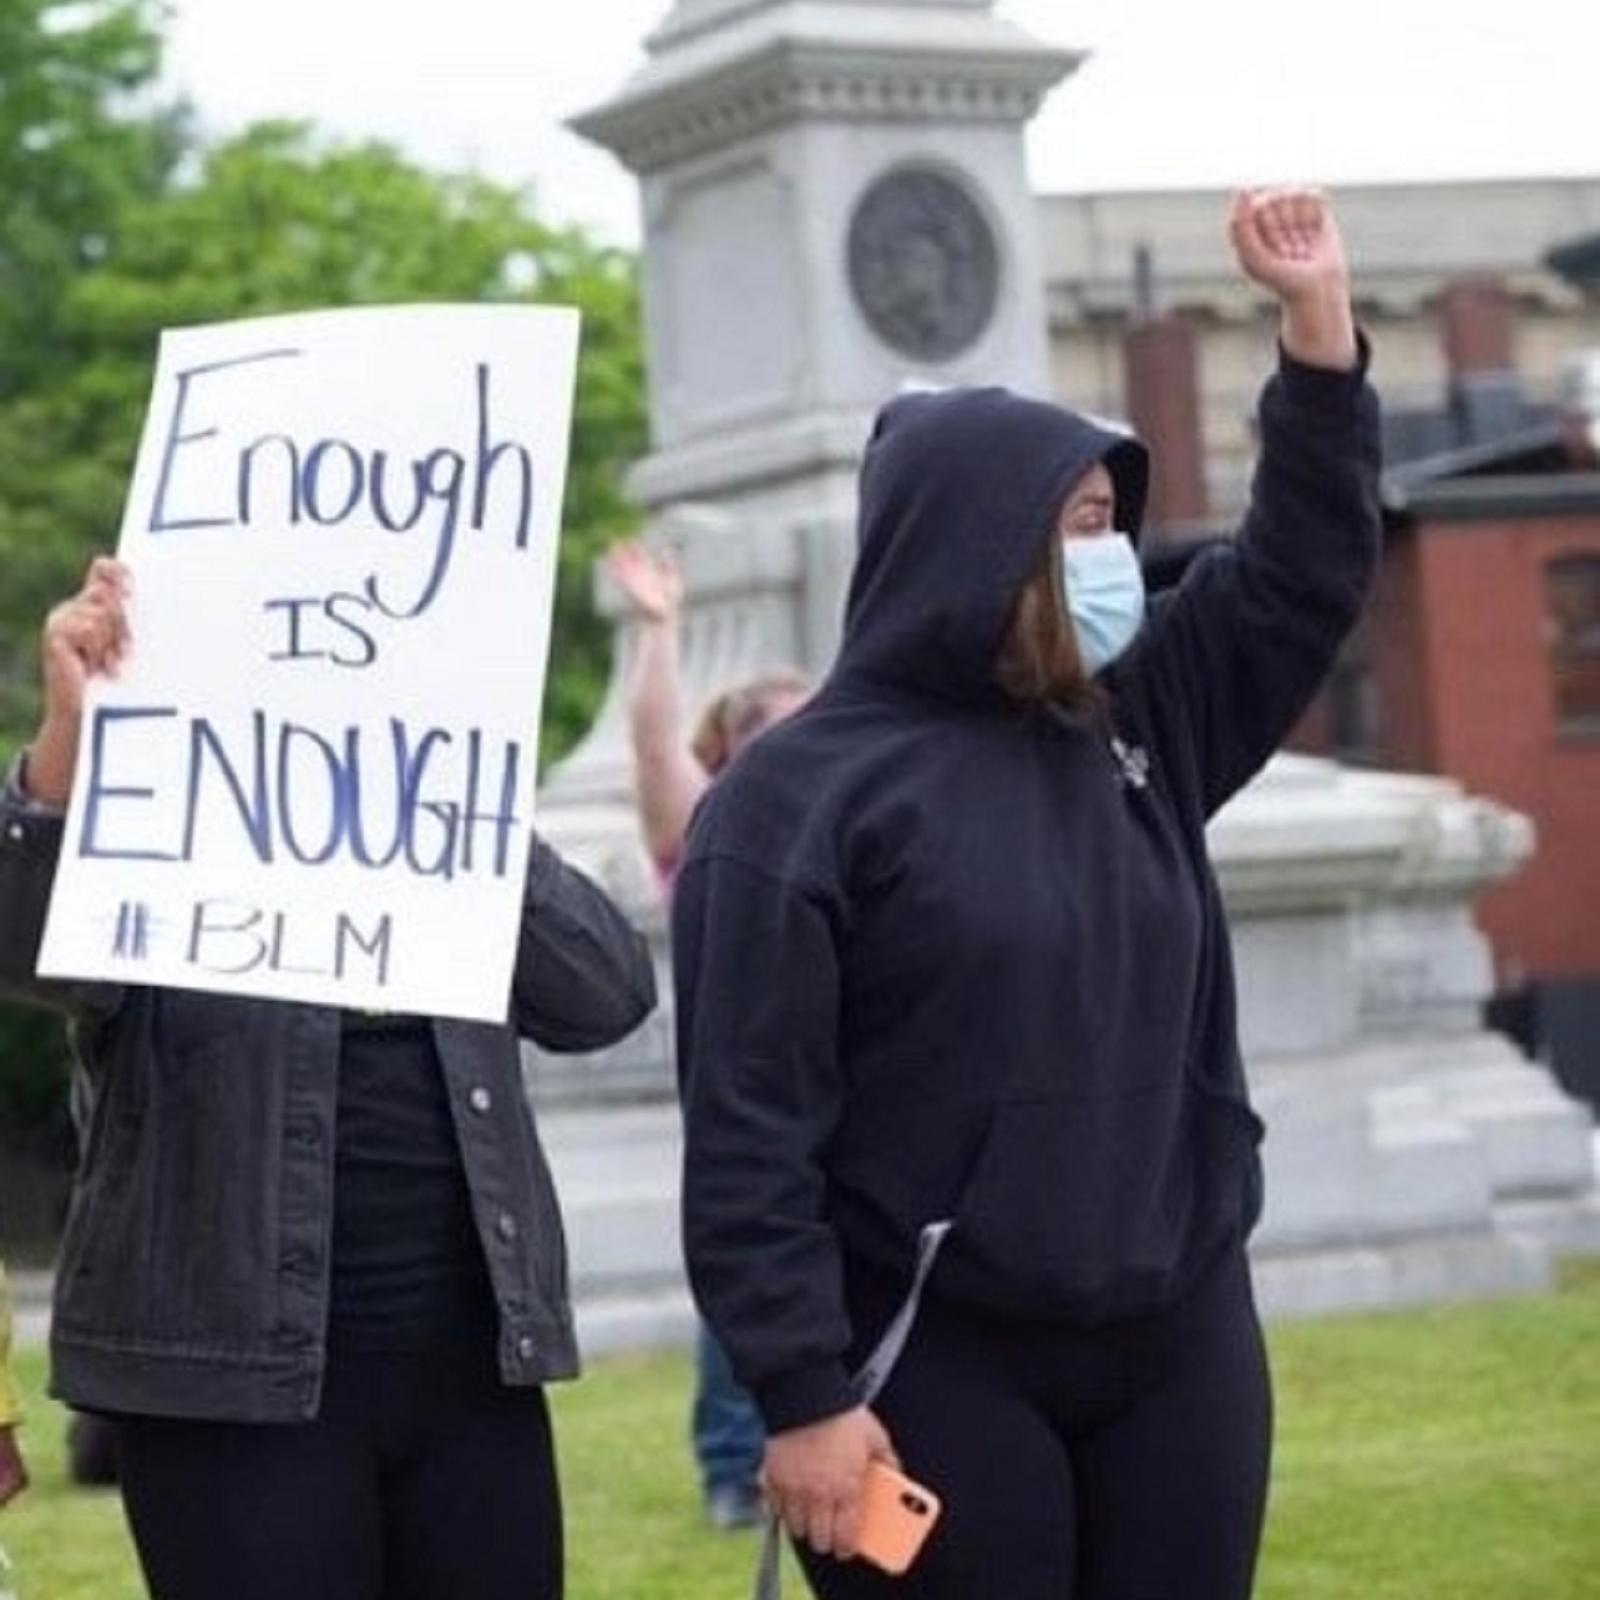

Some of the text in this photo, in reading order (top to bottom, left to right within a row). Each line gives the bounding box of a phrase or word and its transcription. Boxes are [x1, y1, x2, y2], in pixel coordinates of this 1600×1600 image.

[148, 349, 533, 618] Enough
[264, 592, 378, 667] IS
[78, 706, 520, 880] ENOUGH
